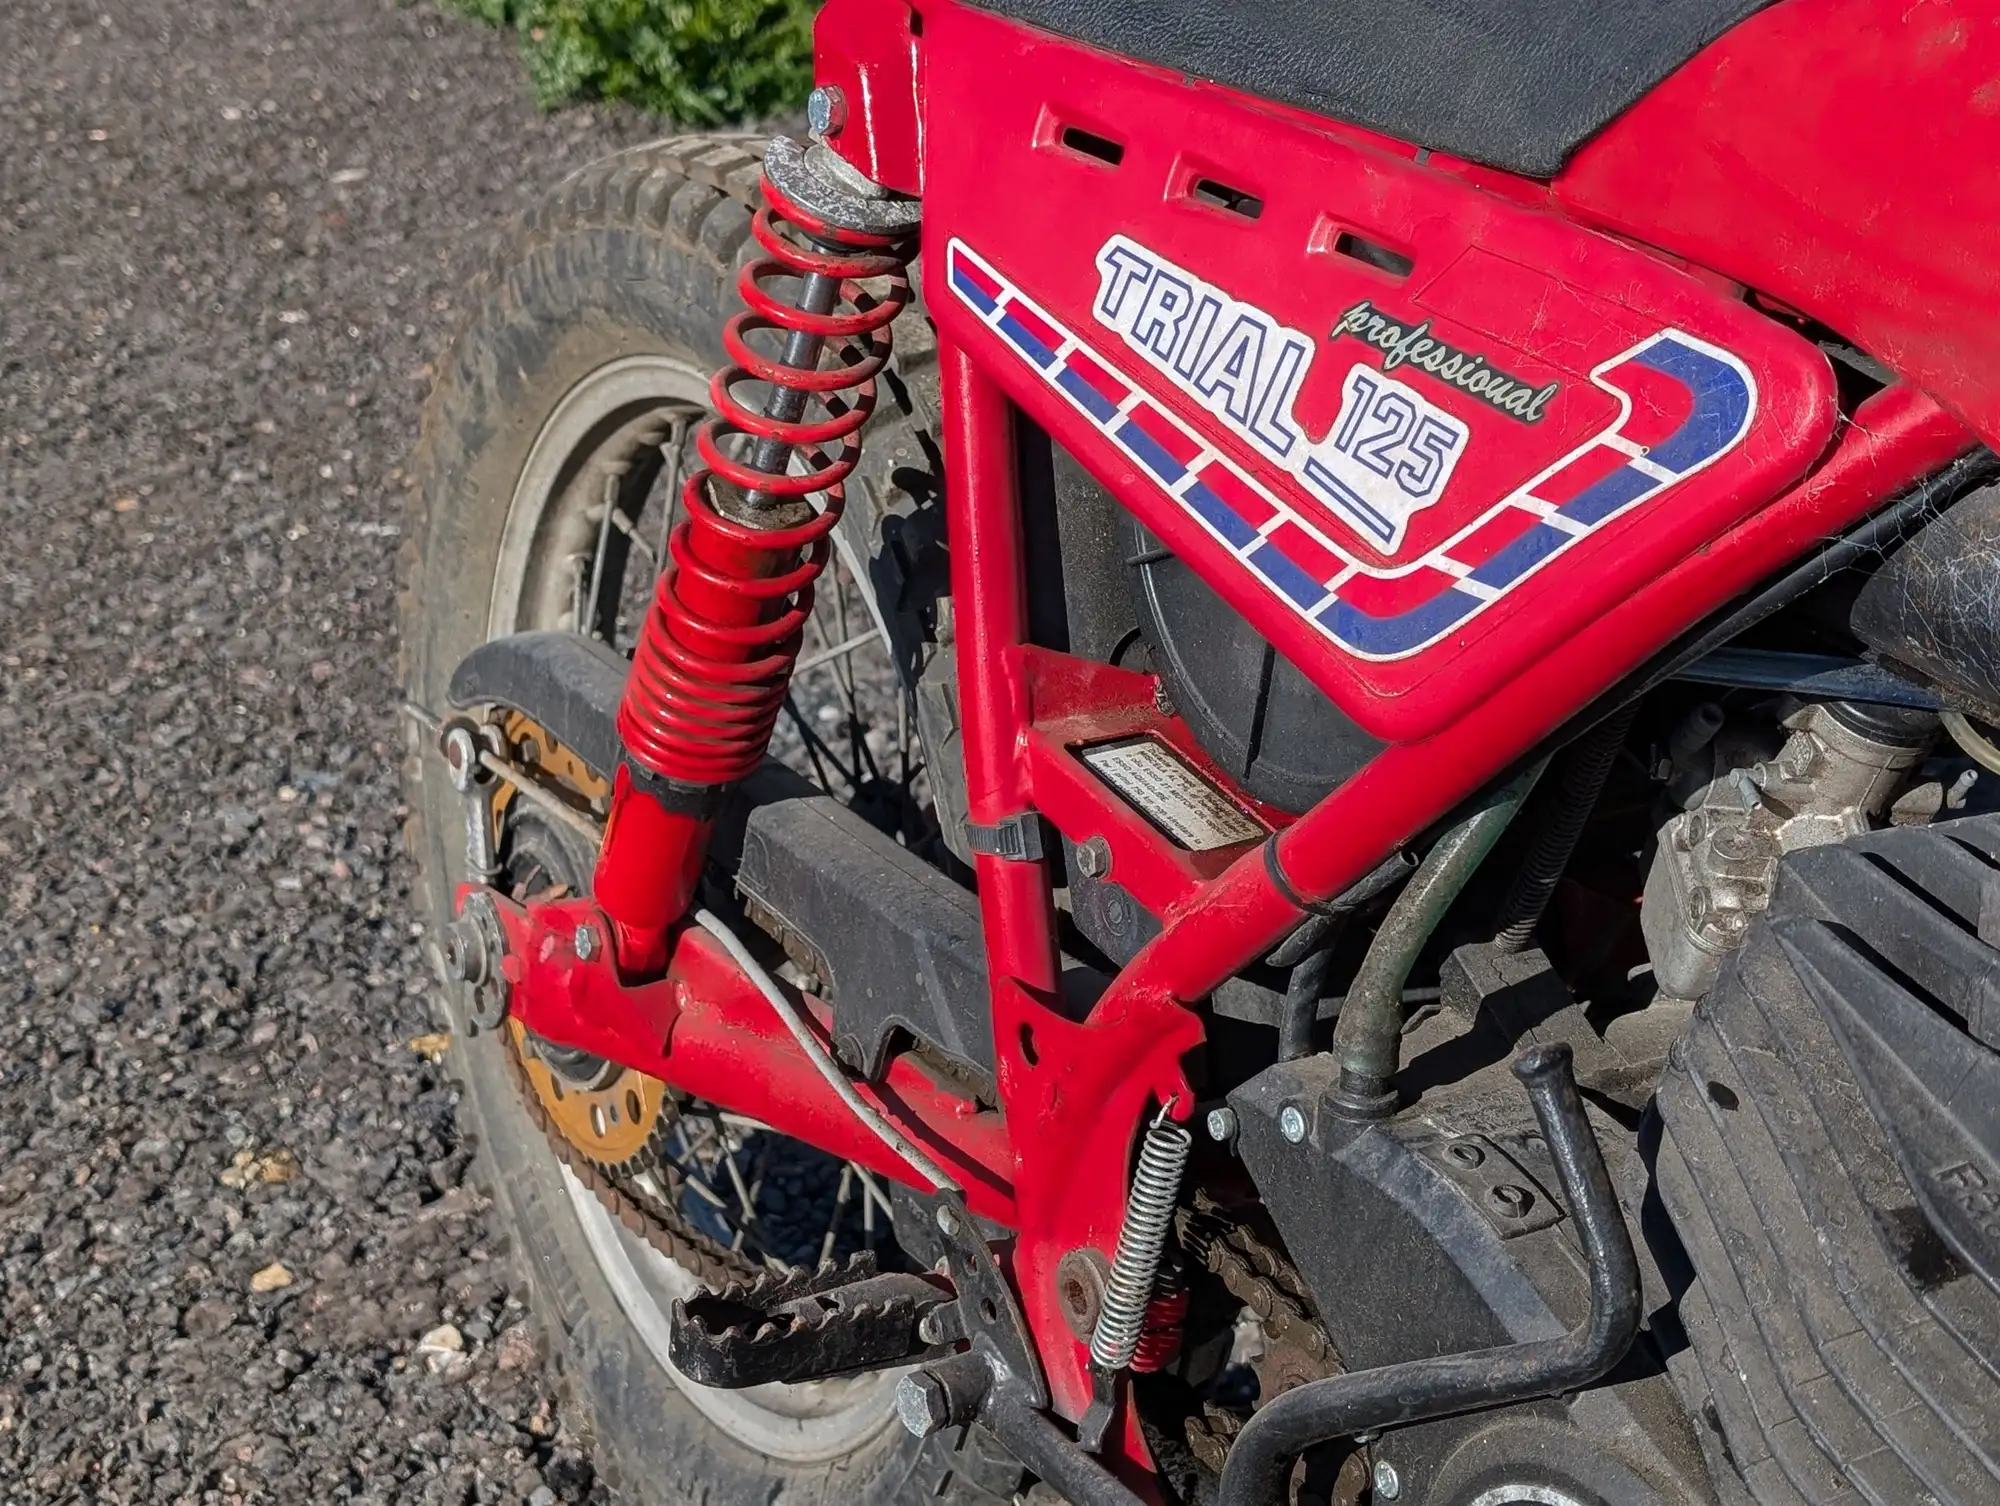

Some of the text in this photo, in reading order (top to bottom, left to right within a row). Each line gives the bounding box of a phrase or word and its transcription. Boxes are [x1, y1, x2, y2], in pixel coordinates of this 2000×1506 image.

[1098, 243, 1462, 499] TRIAL 125
[1332, 300, 1559, 423] professional
